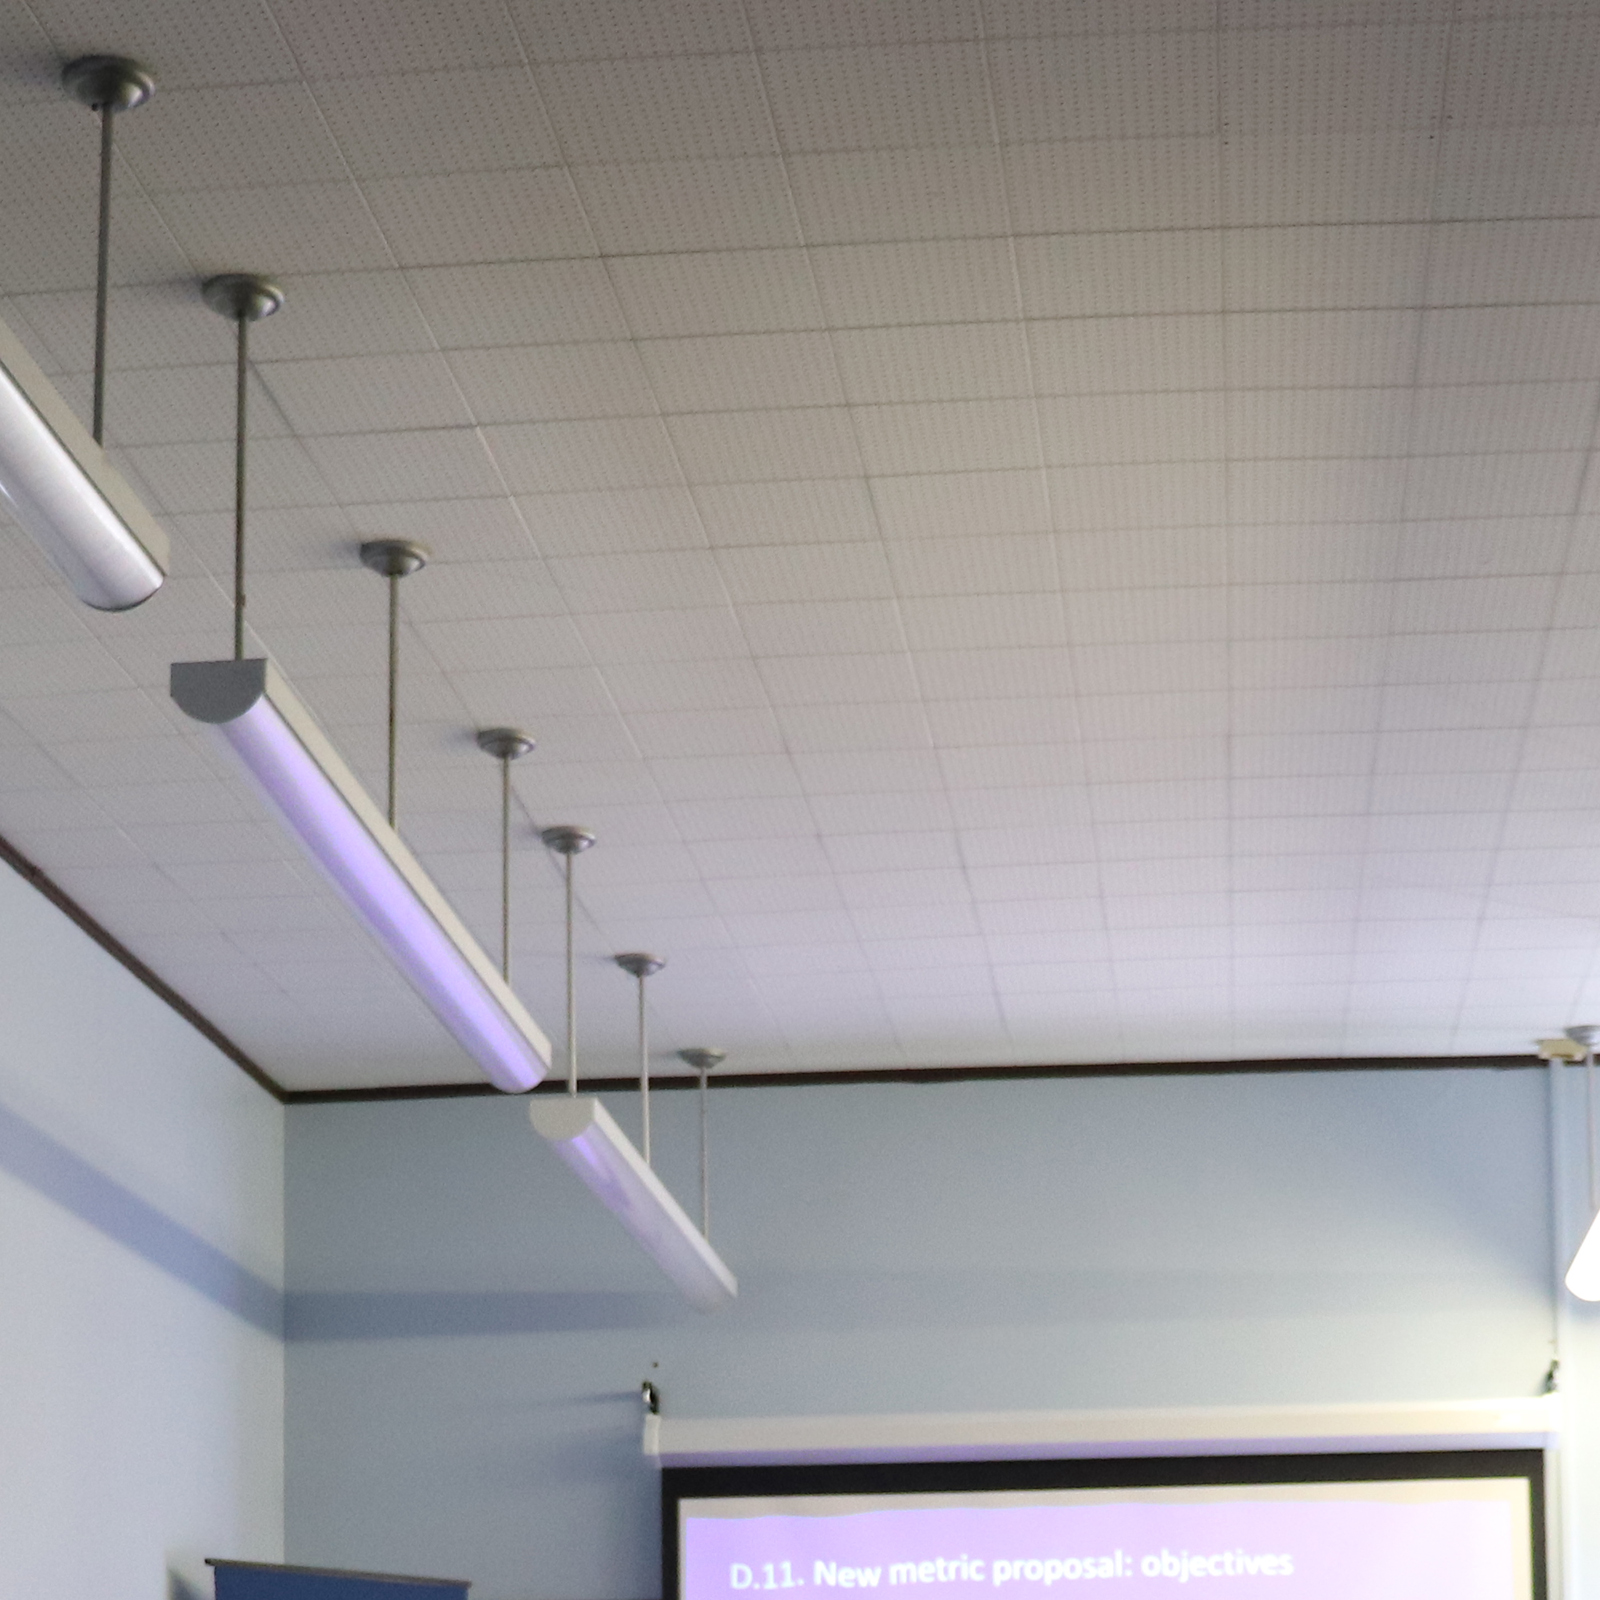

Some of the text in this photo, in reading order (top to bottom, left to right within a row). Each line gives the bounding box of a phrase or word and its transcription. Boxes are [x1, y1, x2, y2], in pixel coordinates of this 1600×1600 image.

[730, 1549, 1295, 1591] D.11. New metric proposal: objectives
